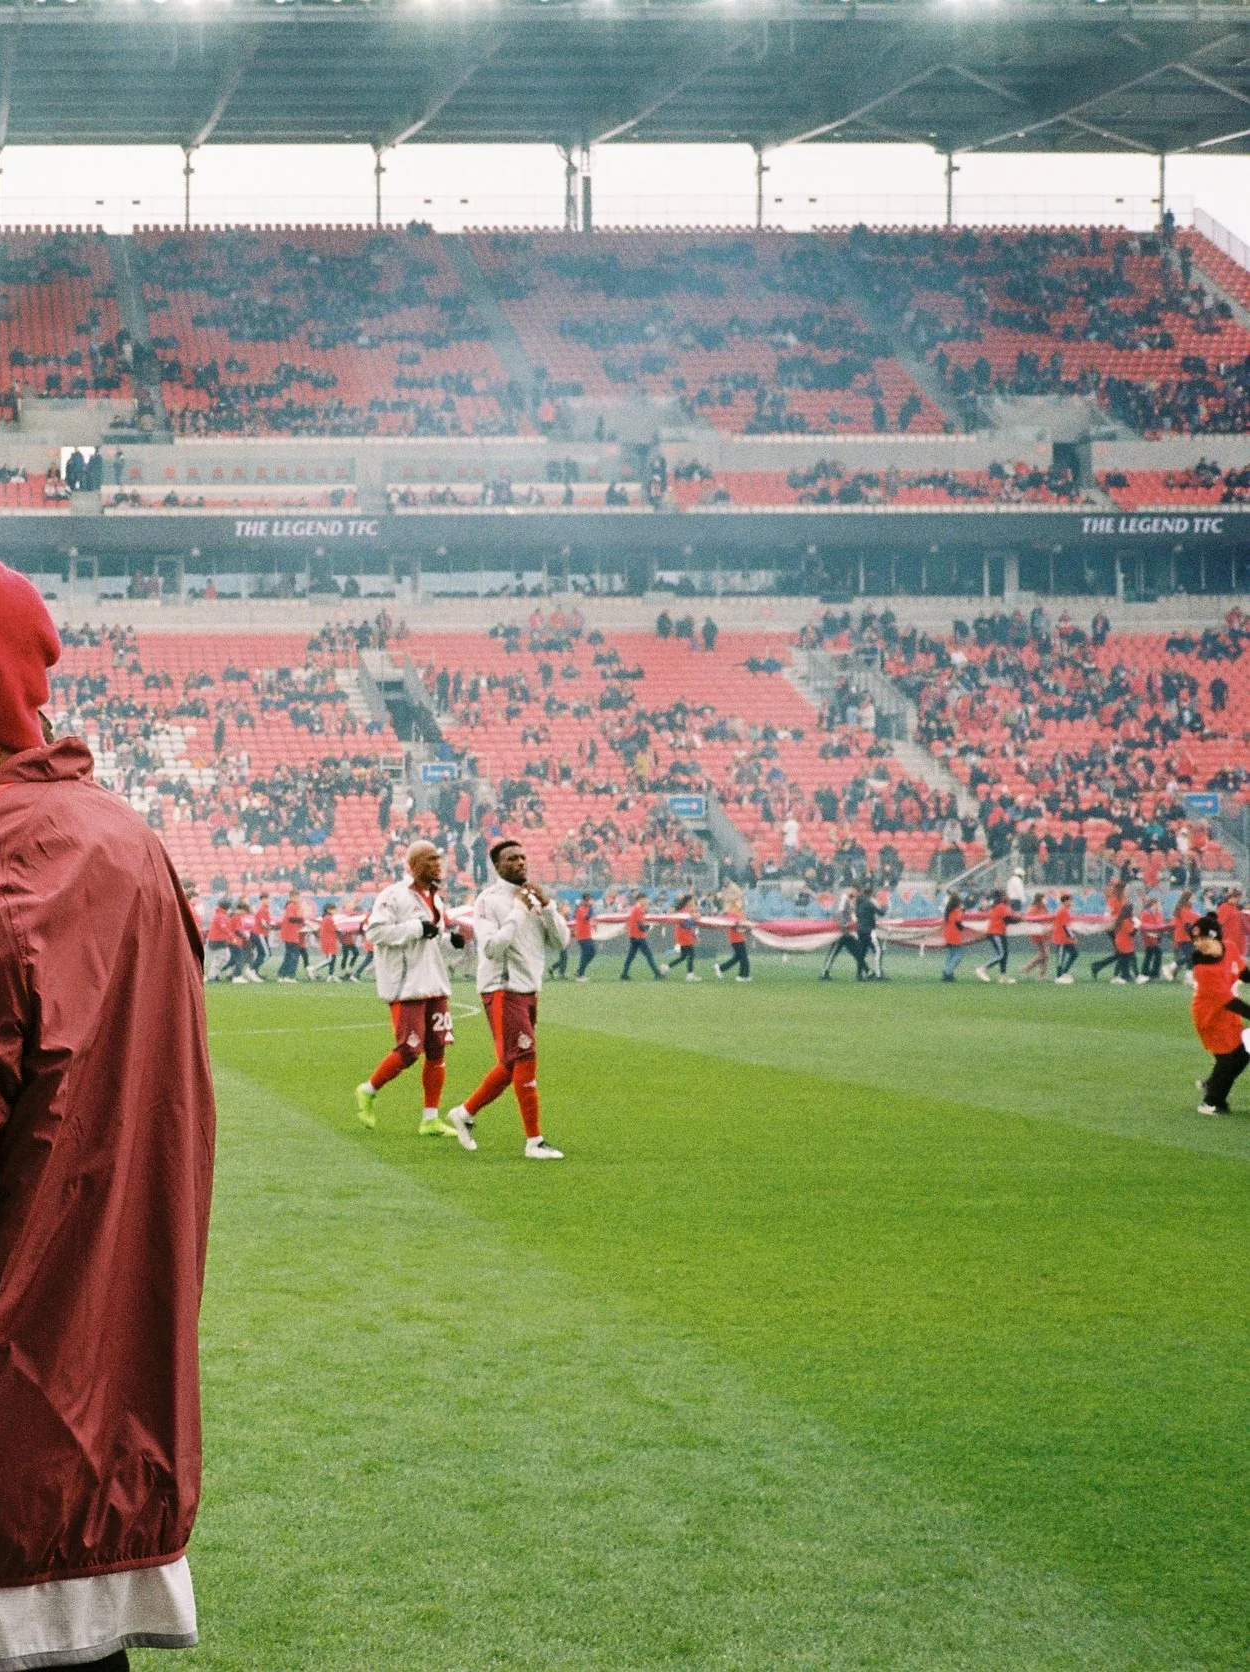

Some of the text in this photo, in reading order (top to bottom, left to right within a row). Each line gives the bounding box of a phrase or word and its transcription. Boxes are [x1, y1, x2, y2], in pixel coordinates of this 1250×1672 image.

[235, 520, 379, 537] THE LEGEND TFC
[1082, 517, 1224, 534] THE LEGEND TFC
[432, 1011, 453, 1031] 20
